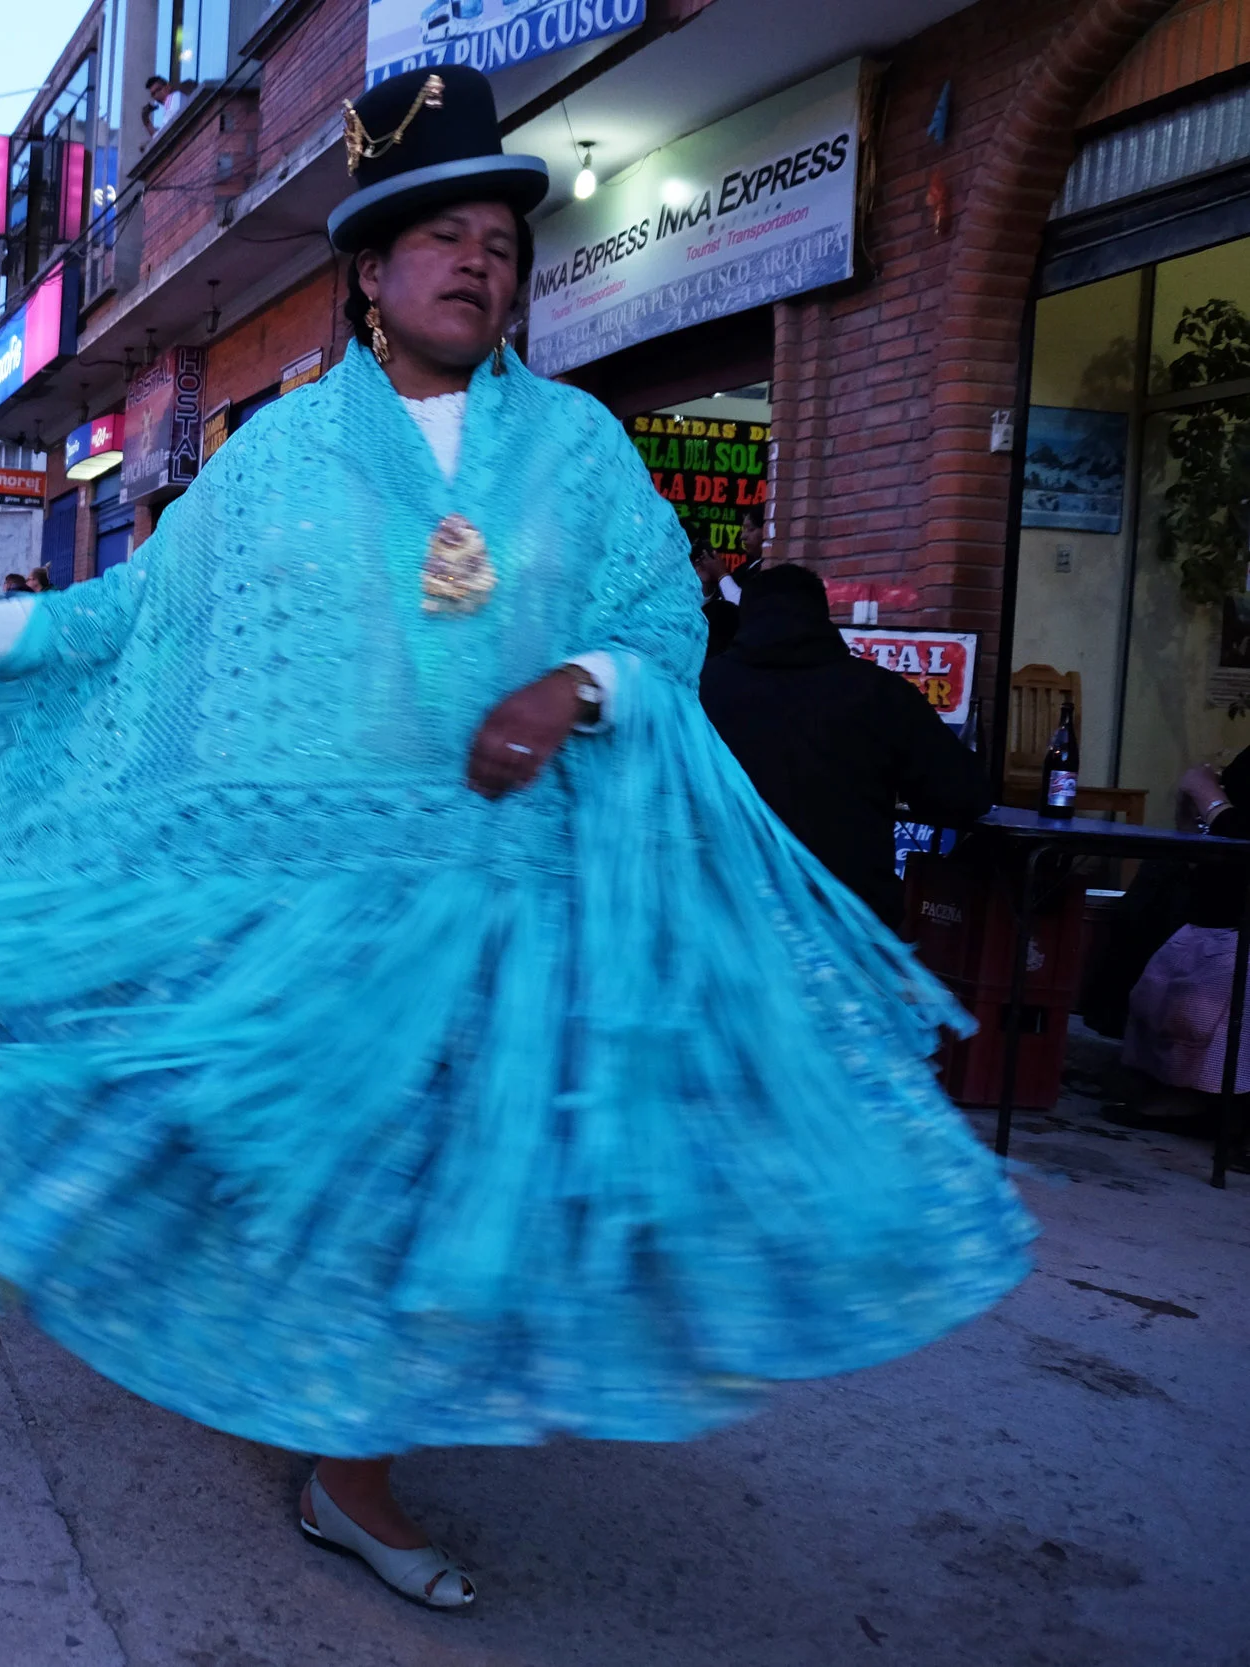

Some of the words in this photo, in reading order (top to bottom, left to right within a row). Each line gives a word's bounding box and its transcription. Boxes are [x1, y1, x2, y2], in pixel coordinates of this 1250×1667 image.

[656, 190, 711, 240] INKA
[717, 133, 850, 216] EXPRESS
[686, 238, 720, 263] Tourist
[727, 206, 810, 247] Transportation
[534, 261, 568, 302] INKA
[570, 218, 650, 284] EXPRESS
[576, 279, 627, 309] Transportation
[126, 358, 174, 410] HOSTAL
[173, 349, 203, 484] HOSTAL
[634, 416, 737, 439] SALIDAS
[684, 439, 710, 472] DEL
[714, 441, 763, 475] SOL
[693, 475, 729, 503] DE
[736, 478, 768, 505] LA
[710, 522, 747, 552] UY
[921, 900, 963, 922] PACEÑA
